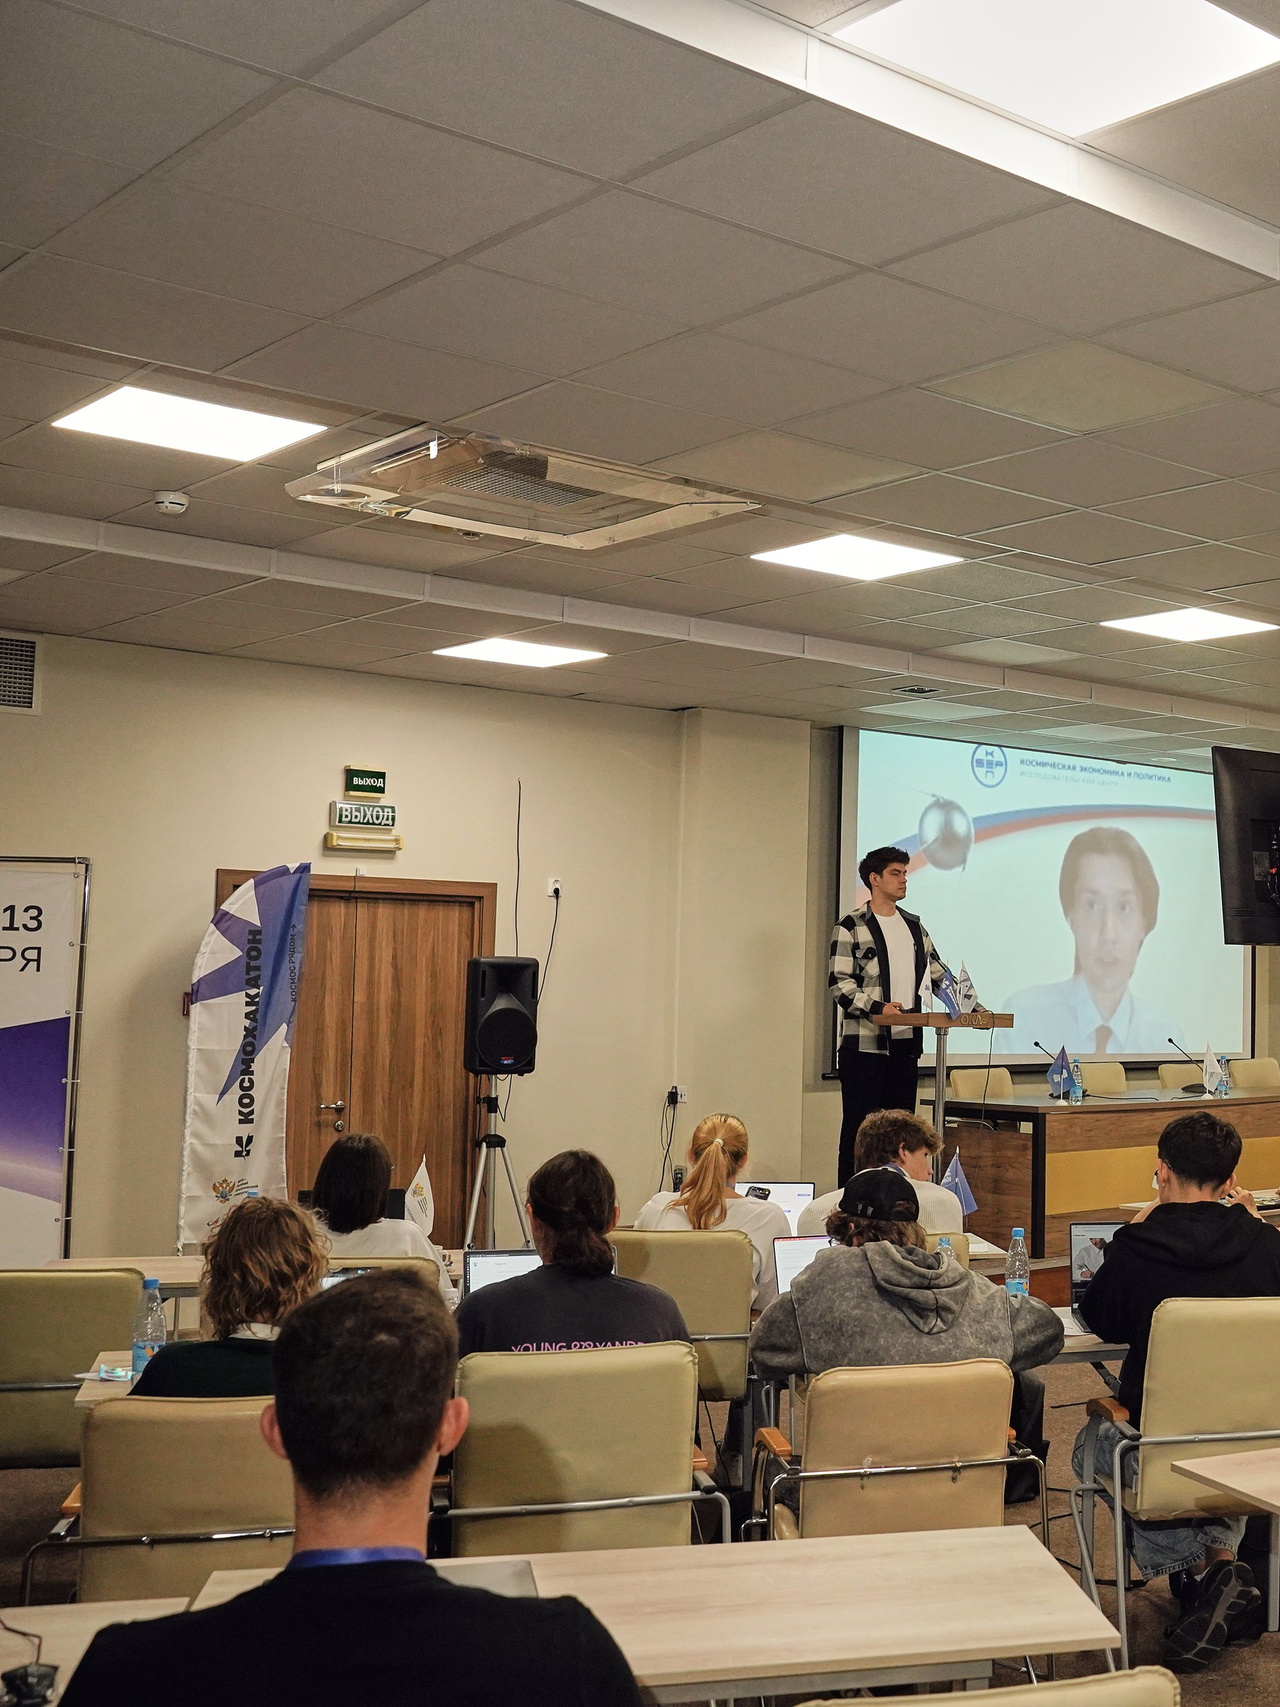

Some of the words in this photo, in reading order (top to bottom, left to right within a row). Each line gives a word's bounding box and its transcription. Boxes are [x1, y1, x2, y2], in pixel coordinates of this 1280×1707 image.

[1019, 758, 1077, 771] КОСМИЧЕСКАЯ
[1079, 766, 1125, 778] ЭКОНОМИКА
[1133, 772, 1172, 783] ПОЛИТИКА
[353, 776, 384, 788] ВЫХОД
[342, 806, 393, 825] ВЫХОД
[238, 929, 262, 1125] КОСМОХАКАТОН
